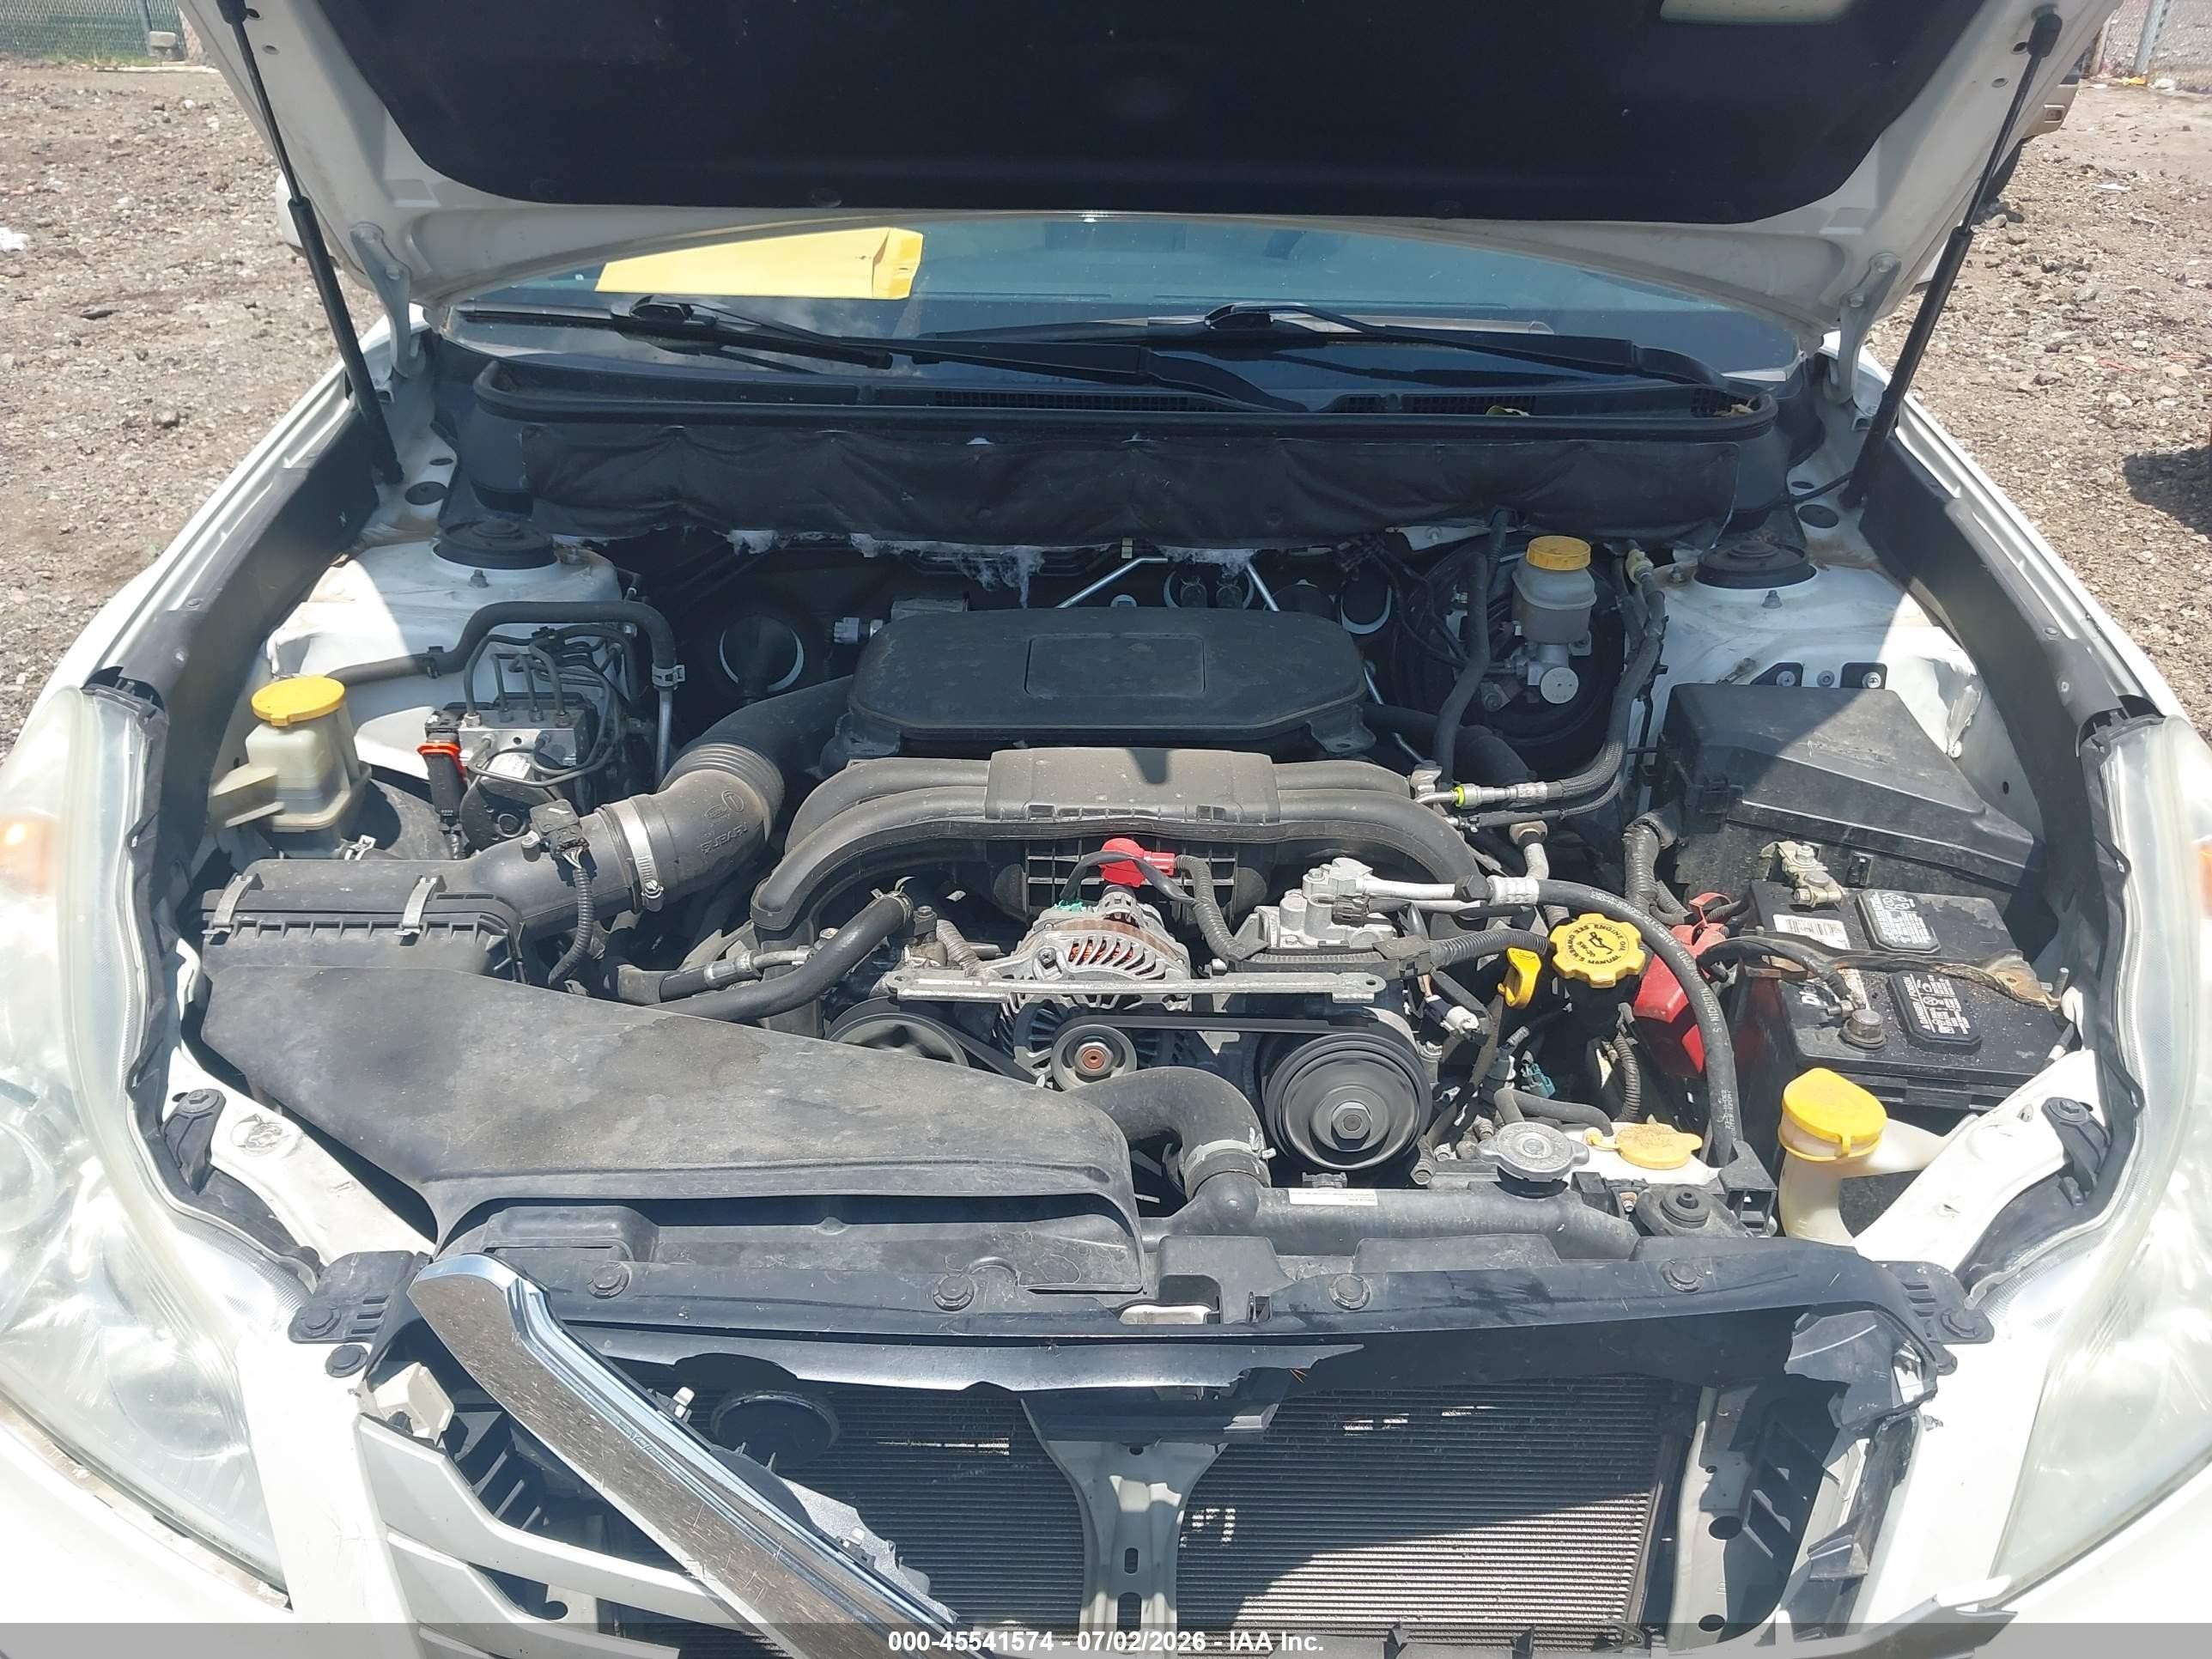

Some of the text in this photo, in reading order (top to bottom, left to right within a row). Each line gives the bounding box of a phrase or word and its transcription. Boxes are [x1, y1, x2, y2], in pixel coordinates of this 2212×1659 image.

[1567, 934, 1586, 962] OWNER'S
[1587, 955, 1622, 965] MANUAL
[1593, 924, 1624, 939] ENGINE
[1618, 940, 1626, 951] OIL
[1902, 976, 1918, 997] POISON
[1911, 1001, 1930, 1025] DANGER
